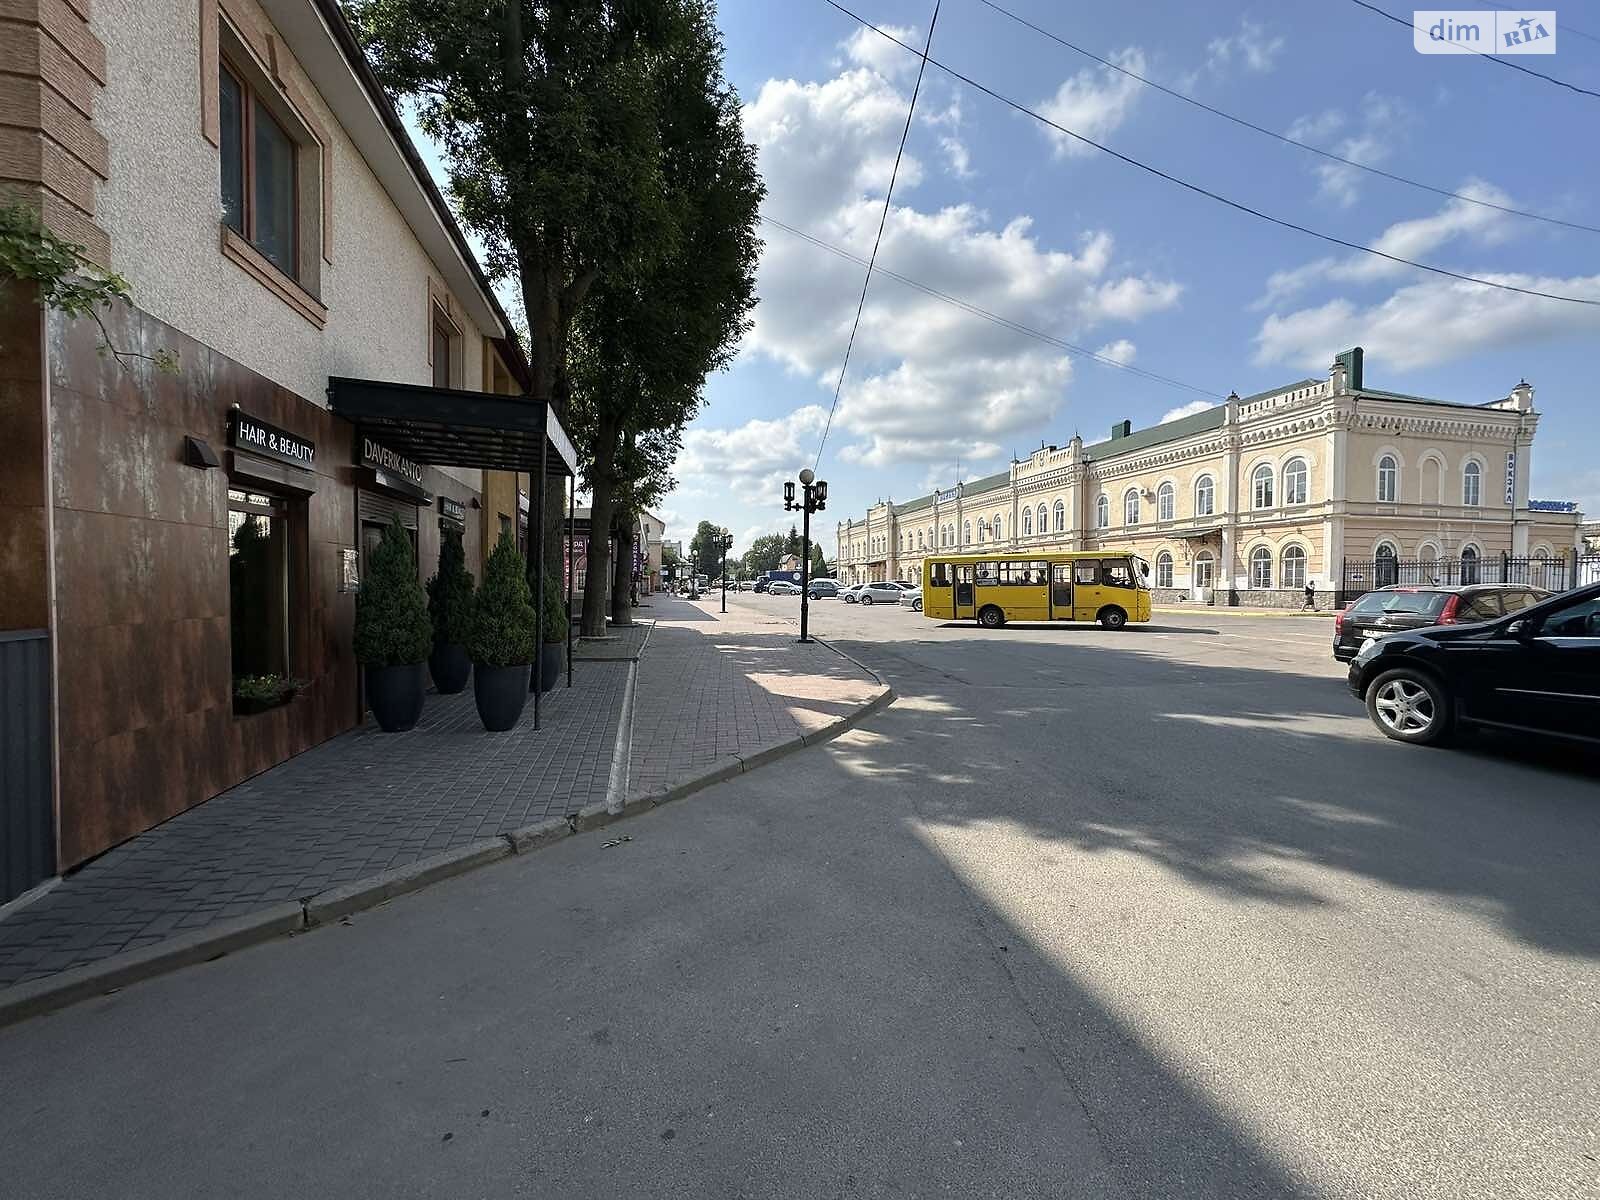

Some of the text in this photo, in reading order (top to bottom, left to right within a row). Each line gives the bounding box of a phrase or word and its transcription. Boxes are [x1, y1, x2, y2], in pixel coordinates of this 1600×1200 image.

[240, 421, 315, 463] HAIR & BEAUTY
[1506, 453, 1514, 502] ВОКЗАЛ
